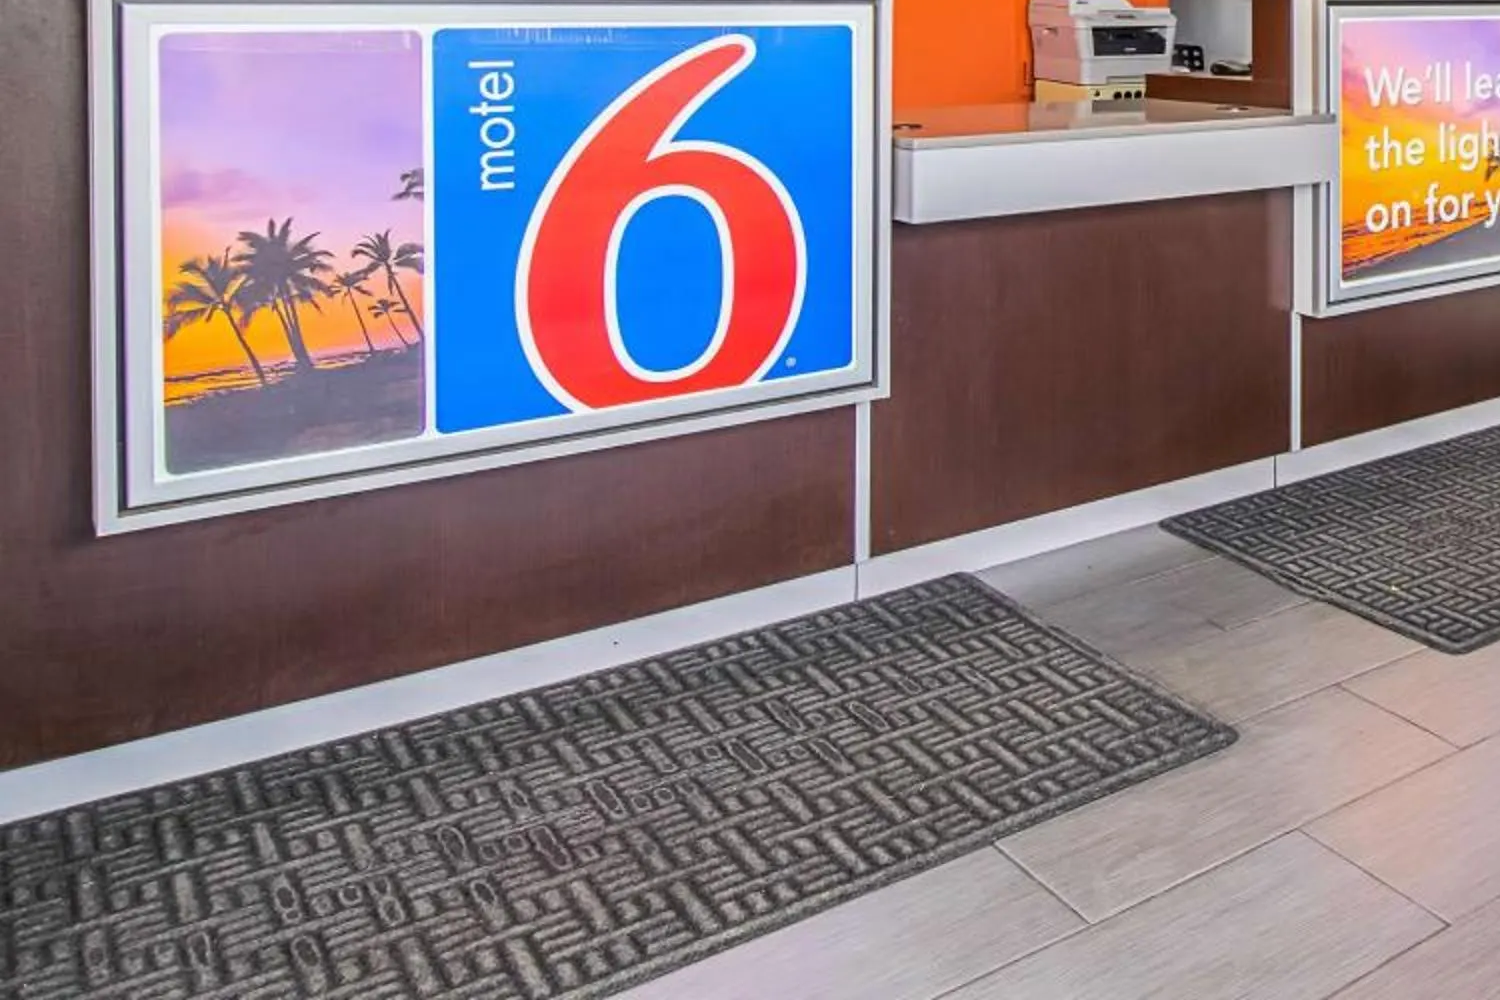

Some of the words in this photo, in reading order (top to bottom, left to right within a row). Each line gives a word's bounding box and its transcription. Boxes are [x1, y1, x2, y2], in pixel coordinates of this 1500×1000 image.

[1364, 60, 1451, 107] We'll
[467, 60, 515, 190] motel
[1364, 125, 1425, 171] the
[514, 33, 807, 414] 6
[1364, 198, 1412, 232] on
[1424, 183, 1476, 224] for
